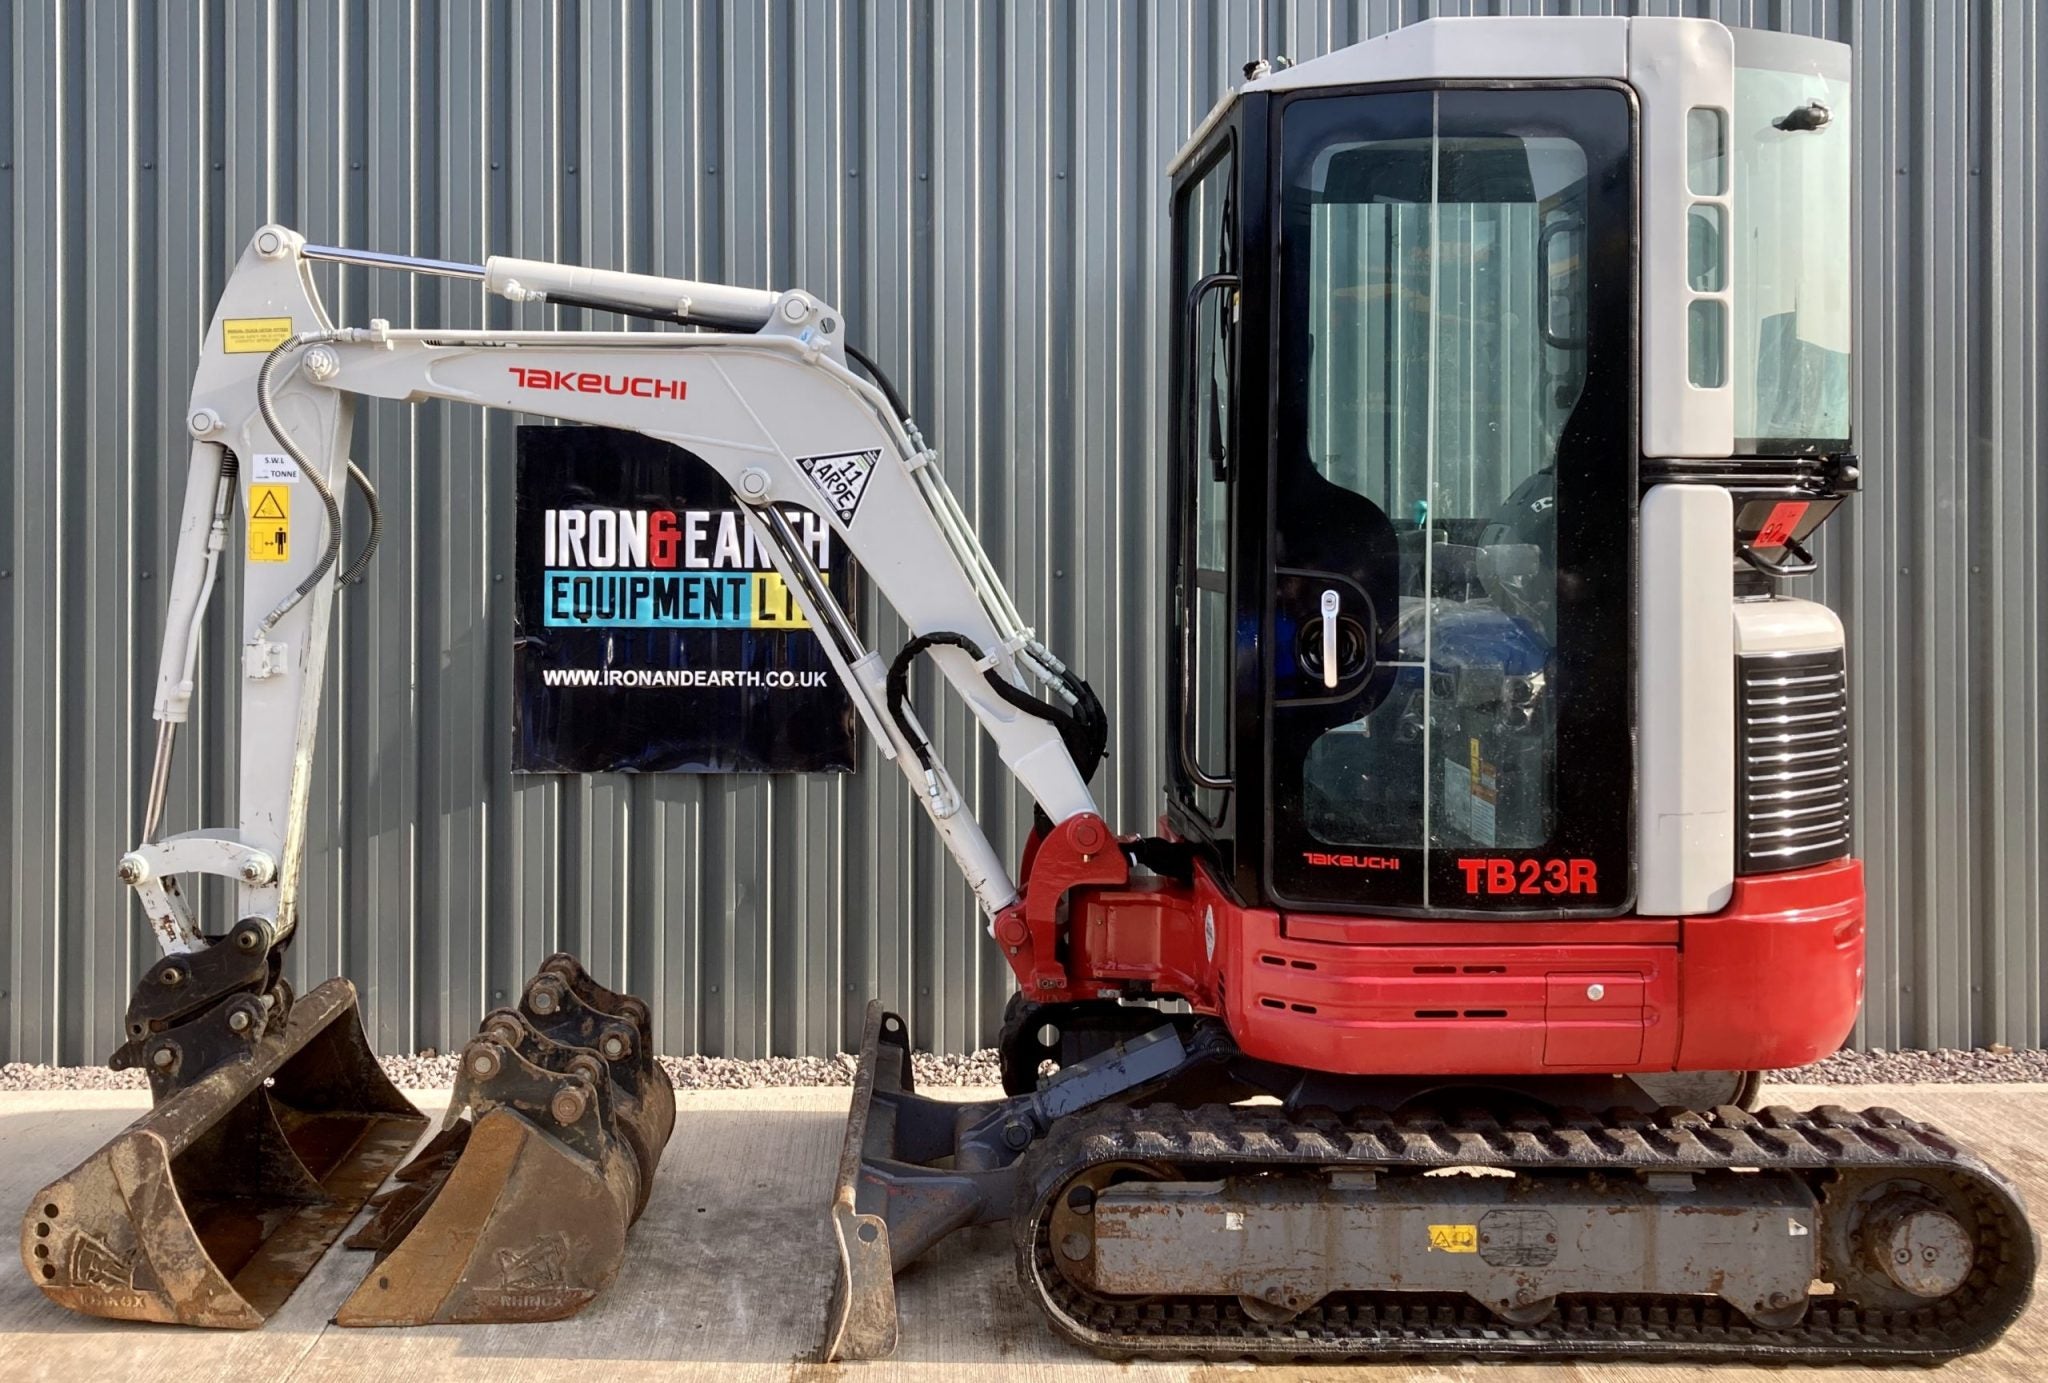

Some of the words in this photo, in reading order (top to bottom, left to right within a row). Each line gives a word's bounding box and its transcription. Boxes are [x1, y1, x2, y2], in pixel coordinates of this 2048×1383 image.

[271, 470, 297, 478] TONNE
[814, 463, 857, 509] AR9E
[838, 460, 863, 487] 11
[551, 576, 746, 624] EQUIPMENT
[758, 577, 809, 621] LT
[543, 669, 828, 688] WWW.IRONANDEARTH.CO.UK
[1458, 859, 1598, 894] TB23R
